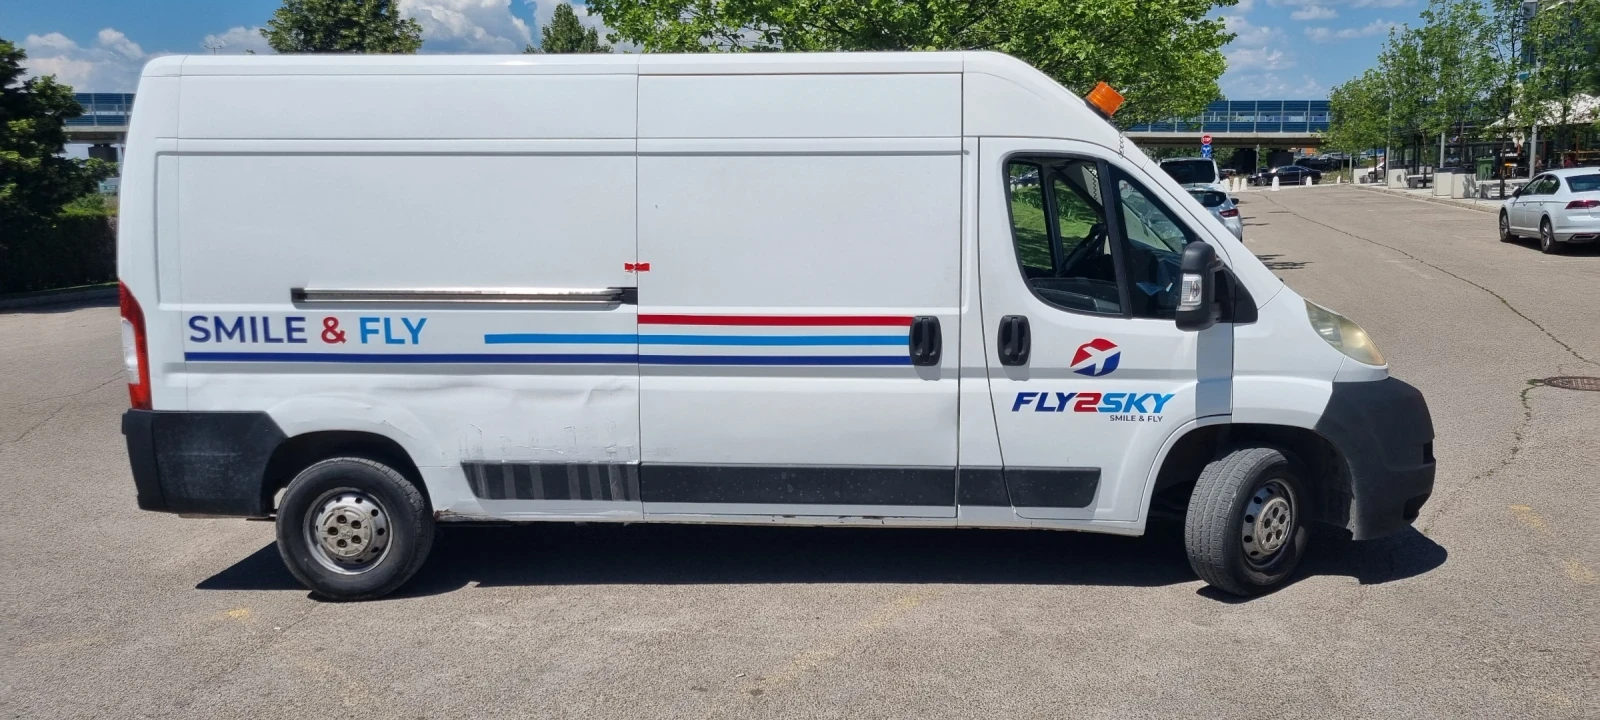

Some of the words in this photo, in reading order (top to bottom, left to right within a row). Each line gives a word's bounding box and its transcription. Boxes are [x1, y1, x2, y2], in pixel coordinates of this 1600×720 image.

[188, 315, 308, 343] SMILE
[321, 316, 347, 344] &
[359, 316, 428, 345] FLY
[1011, 392, 1175, 413] FLY2SKY
[1109, 414, 1136, 422] SMILE
[1147, 415, 1163, 423] FLY
